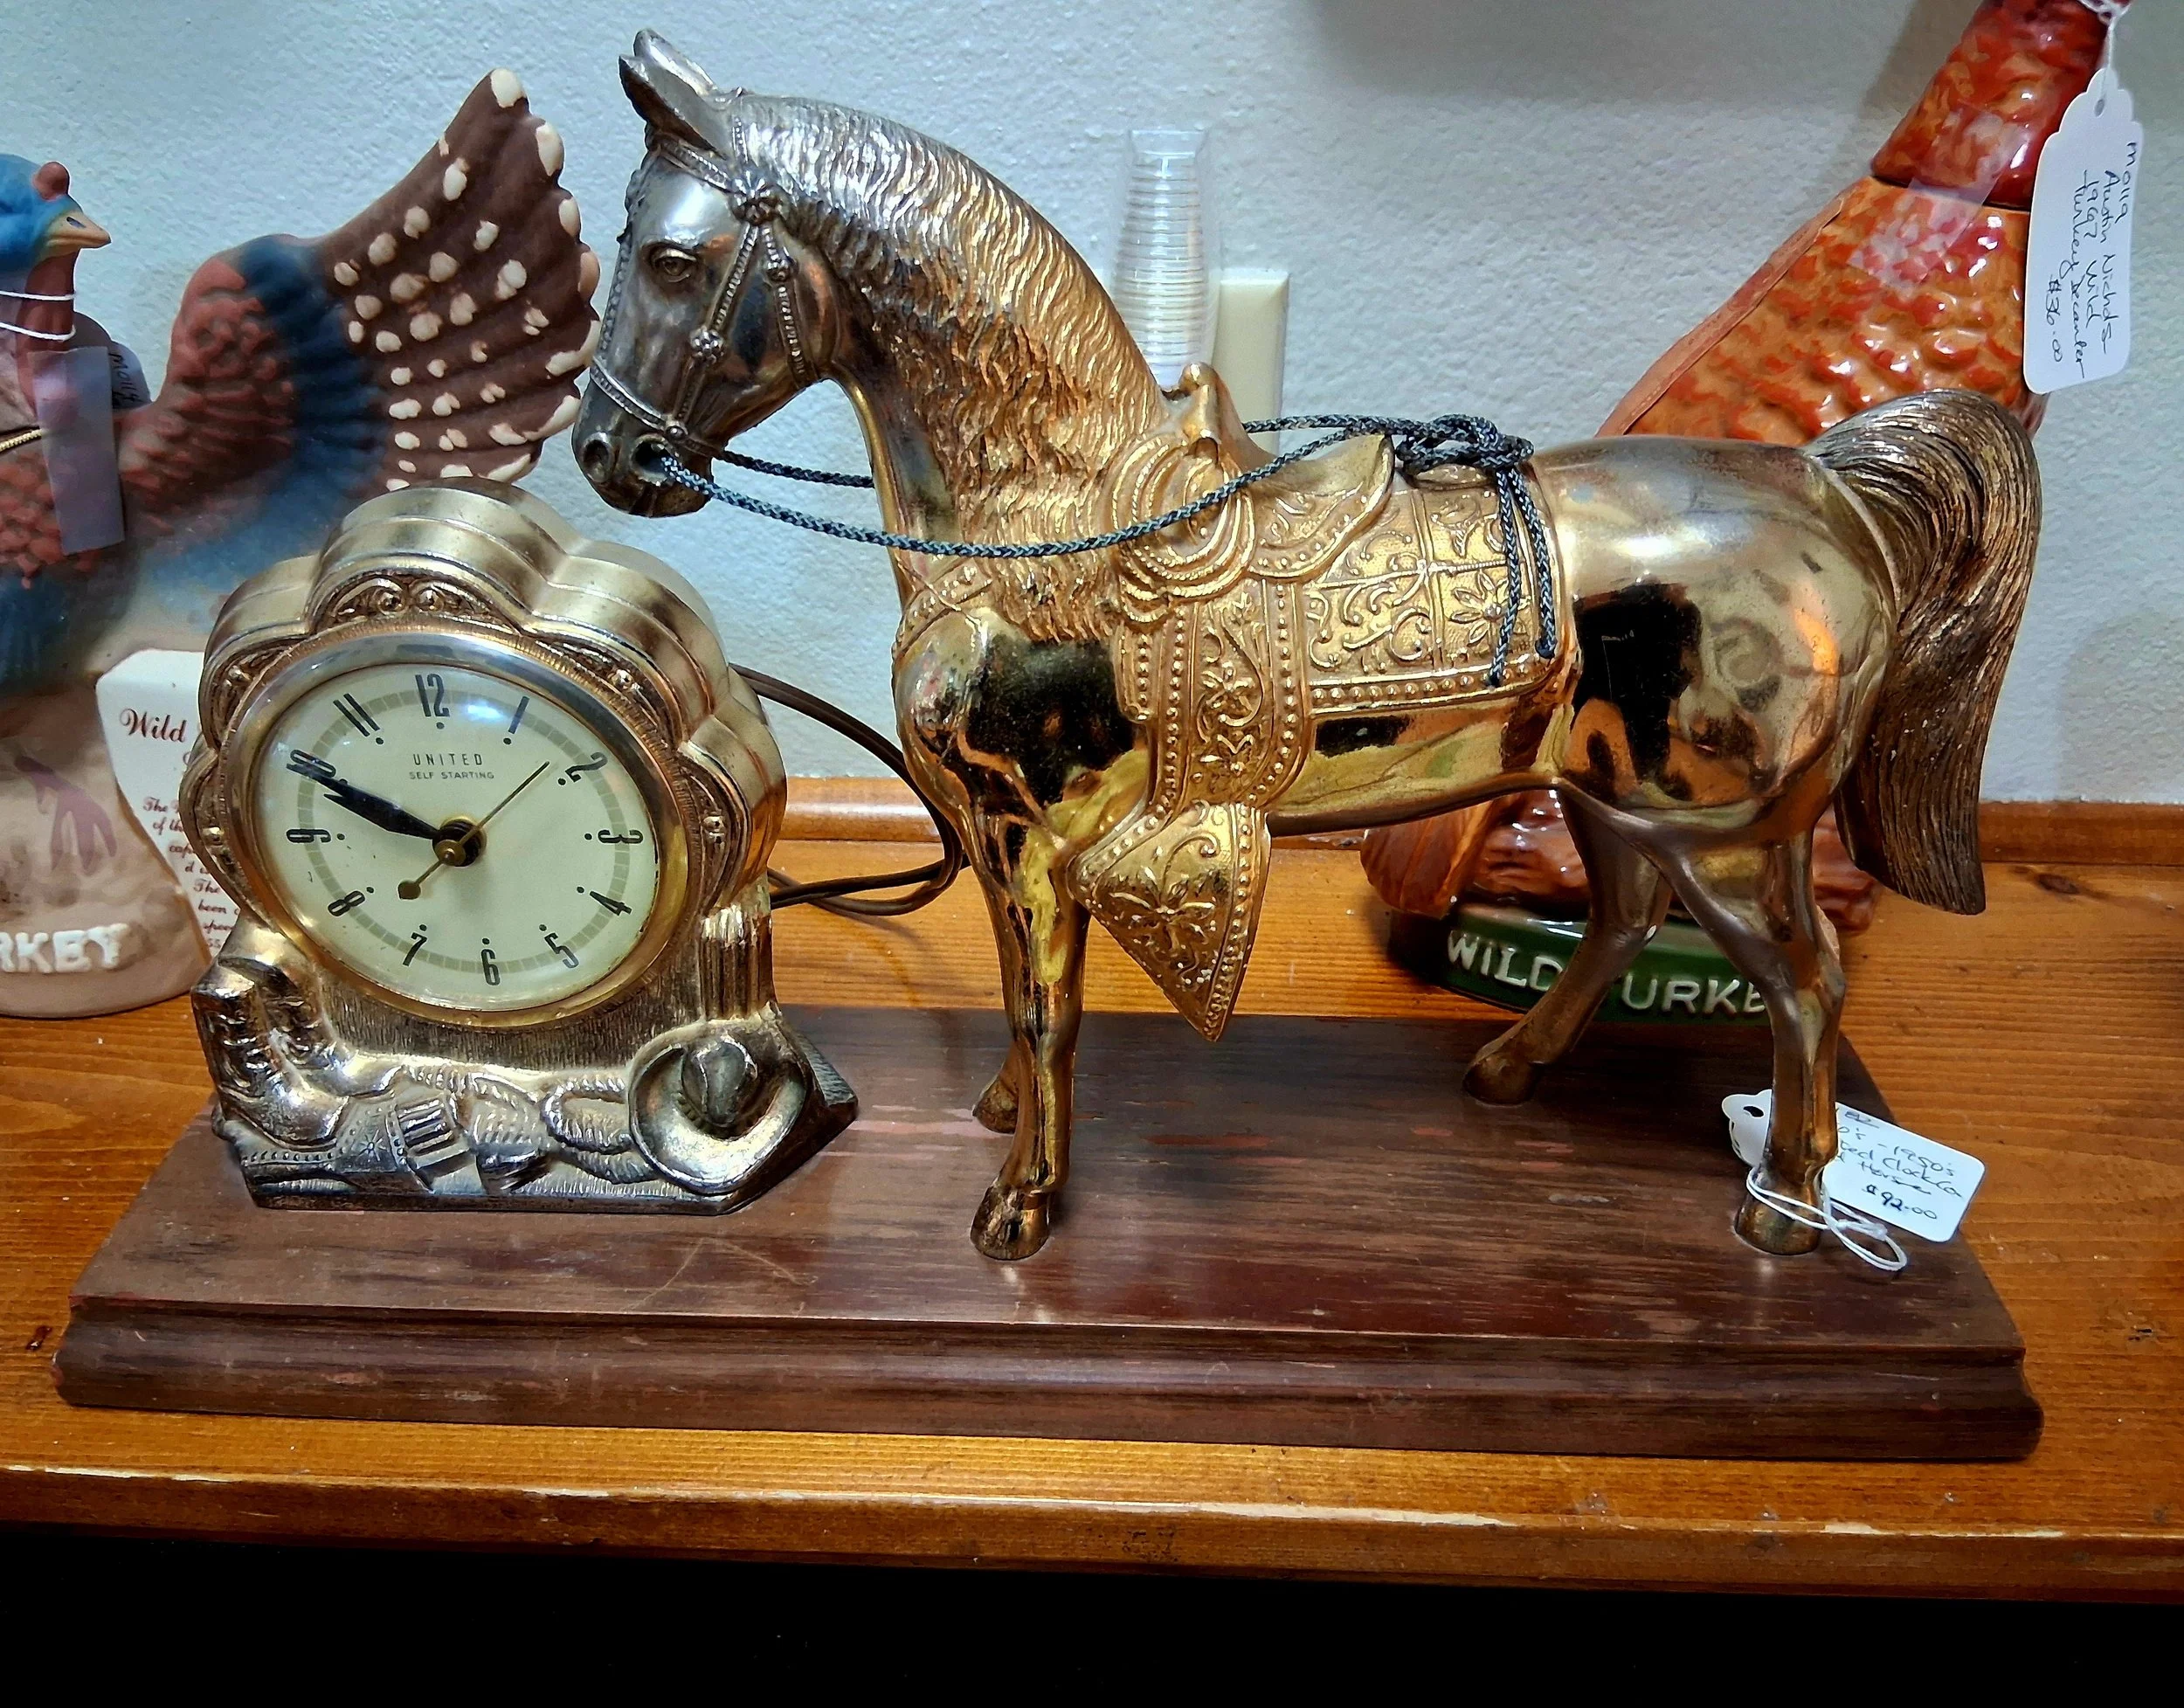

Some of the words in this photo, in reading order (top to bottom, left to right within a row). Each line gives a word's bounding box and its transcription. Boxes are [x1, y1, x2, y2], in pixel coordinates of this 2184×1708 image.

[2085, 260, 2102, 328] Wild
[415, 674, 450, 719] 12
[120, 708, 187, 743] Wild
[333, 693, 381, 737] 11
[508, 696, 529, 735] 1
[412, 753, 482, 766] UNITED
[565, 751, 608, 783] 2
[142, 796, 169, 813] The
[286, 828, 332, 845] 9
[598, 829, 645, 845] 3
[328, 890, 366, 917] 8
[590, 890, 632, 916] 4
[403, 932, 427, 966] 7
[544, 933, 580, 969] 5
[1448, 930, 1564, 992] WILD
[481, 949, 501, 986] 6
[1621, 973, 1766, 1013] URKE
